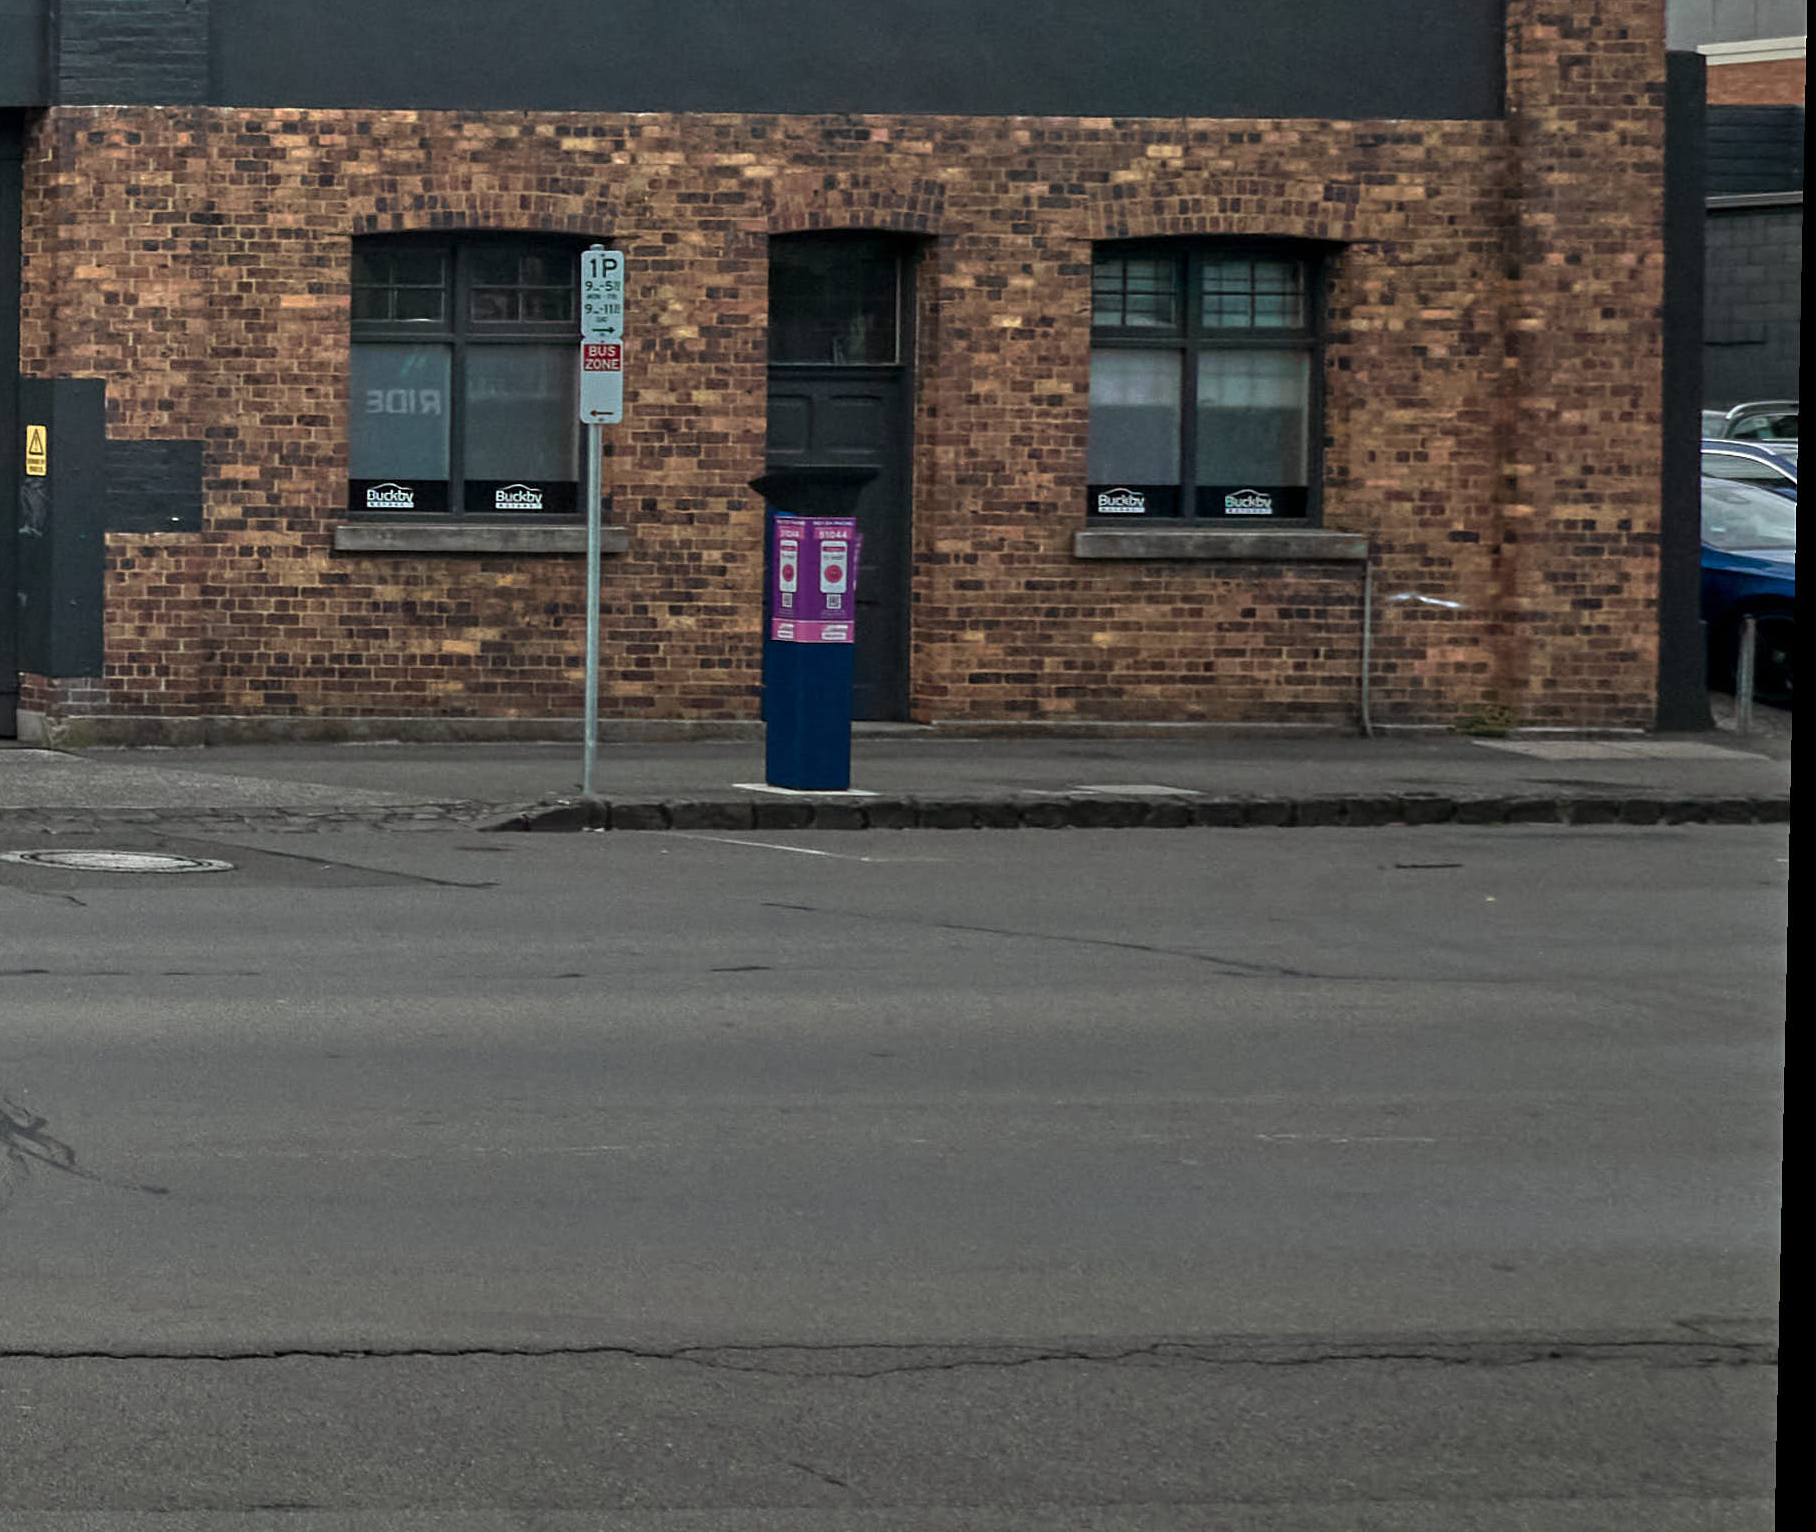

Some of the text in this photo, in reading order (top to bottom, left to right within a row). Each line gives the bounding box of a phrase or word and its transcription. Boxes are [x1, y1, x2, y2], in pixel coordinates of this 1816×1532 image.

[590, 258, 617, 278] 1P
[589, 345, 616, 357] BUS
[585, 358, 620, 370] ZONE
[367, 489, 414, 503] Buckby
[496, 490, 542, 505] Buckby
